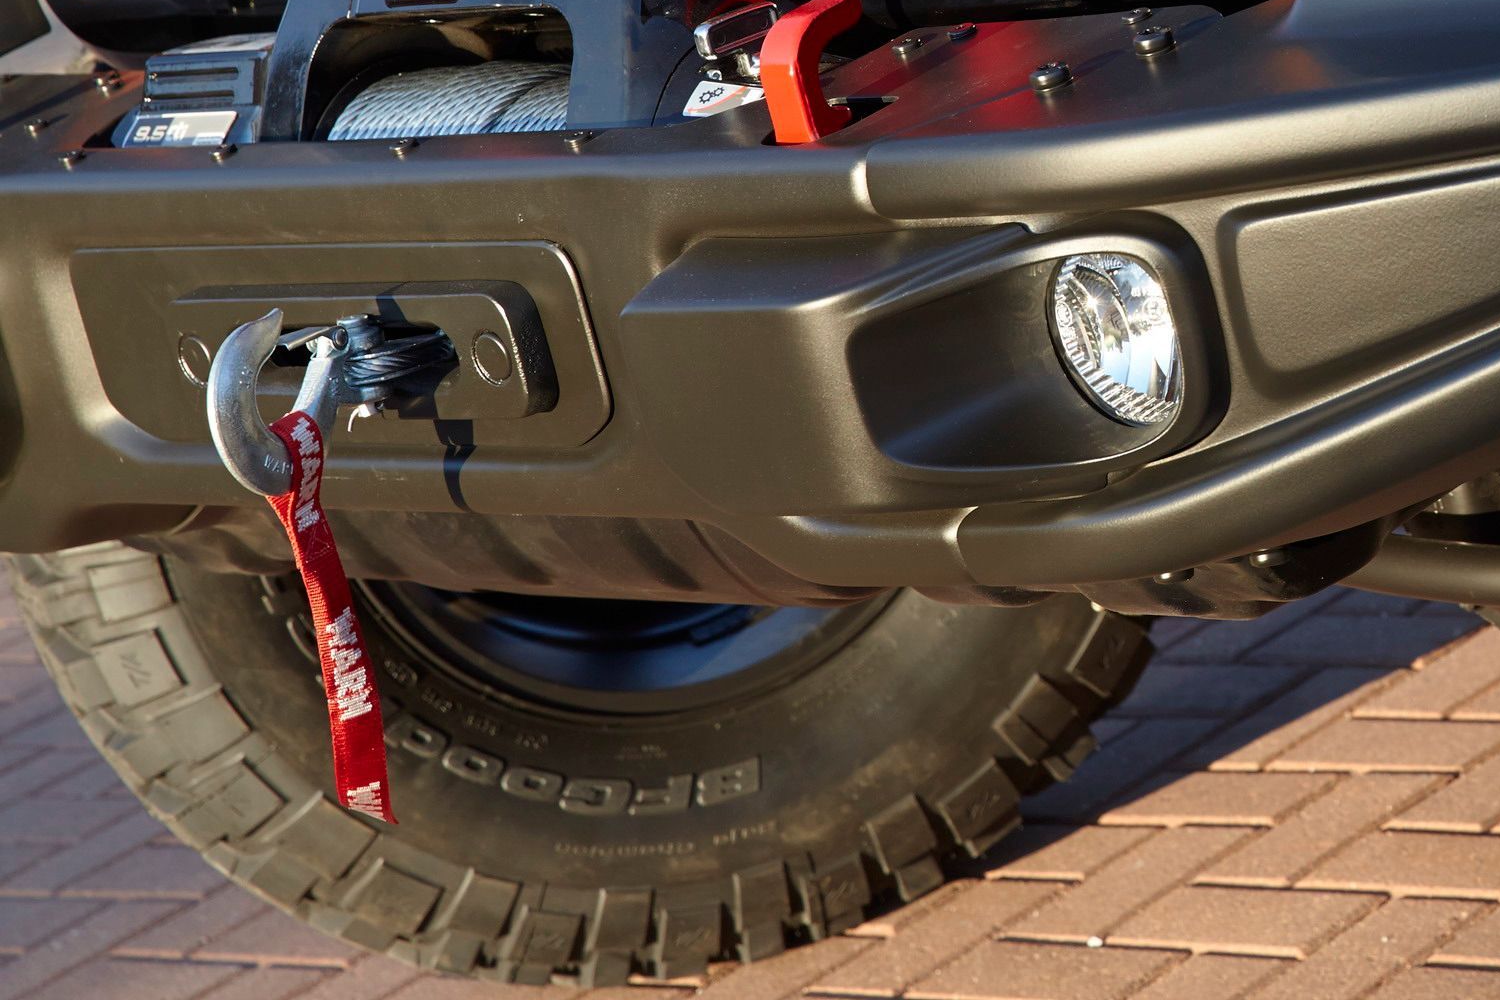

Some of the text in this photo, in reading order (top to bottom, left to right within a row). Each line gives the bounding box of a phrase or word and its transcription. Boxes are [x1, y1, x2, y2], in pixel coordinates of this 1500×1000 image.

[290, 417, 322, 533] WARN
[326, 606, 373, 722] WARN
[384, 716, 762, 816] BFGOOD
